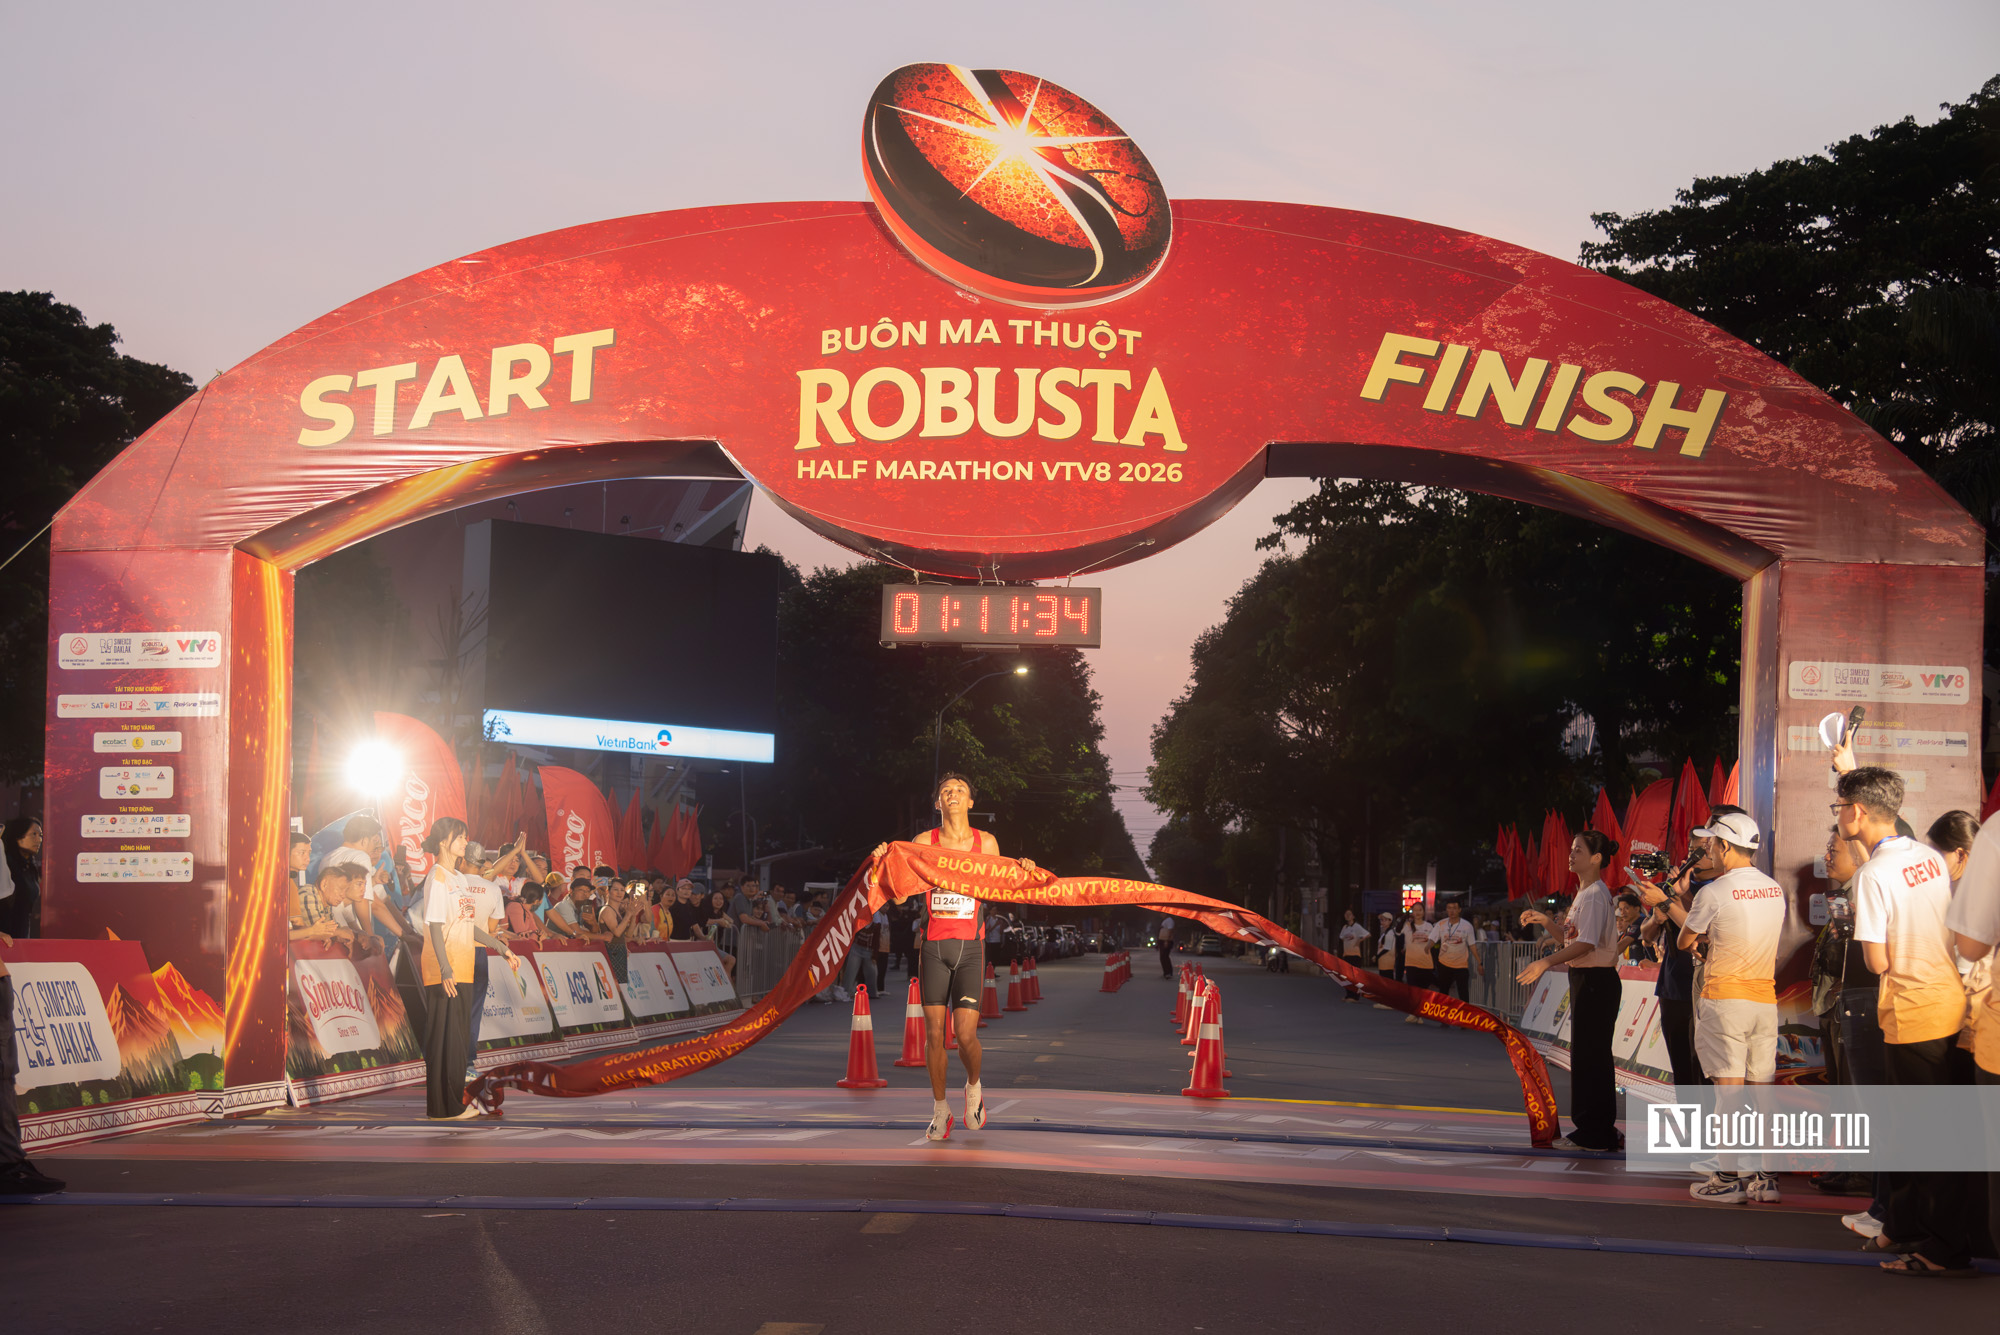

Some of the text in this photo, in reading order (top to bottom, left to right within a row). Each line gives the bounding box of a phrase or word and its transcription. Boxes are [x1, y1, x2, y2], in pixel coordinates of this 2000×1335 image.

[821, 317, 1142, 359] BUÔN MA THUỘT
[297, 328, 616, 447] START
[1359, 332, 1727, 458] FINISH
[794, 367, 1188, 452] ROBUSTA
[797, 460, 1183, 482] HALF MARATHON VTV8 2026
[895, 593, 1088, 636] 01:11:34
[141, 640, 164, 648] ROBUSTA
[177, 639, 217, 653] VTV8
[1850, 668, 1869, 677] SIMEXCO
[1850, 677, 1869, 685] DAKLAK
[1920, 674, 1964, 688] VTV8
[597, 734, 657, 750] VietinBank
[937, 855, 987, 876] BUÔN
[991, 864, 1018, 880] MA
[1902, 857, 1941, 888] CREW
[974, 883, 1073, 900] MARATHON
[1078, 880, 1120, 895] VTV8
[1125, 880, 1165, 892] 2026
[1732, 887, 1783, 900] ORGANIZER
[37, 980, 87, 1018] SIMEXCO
[301, 974, 365, 1020] Simexco
[566, 971, 593, 1004] ACB
[1421, 1001, 1480, 1025] VTV8 2026
[49, 1022, 103, 1065] DAKLAK
[601, 1069, 637, 1086] HALF
[637, 1046, 722, 1078] MARATHON
